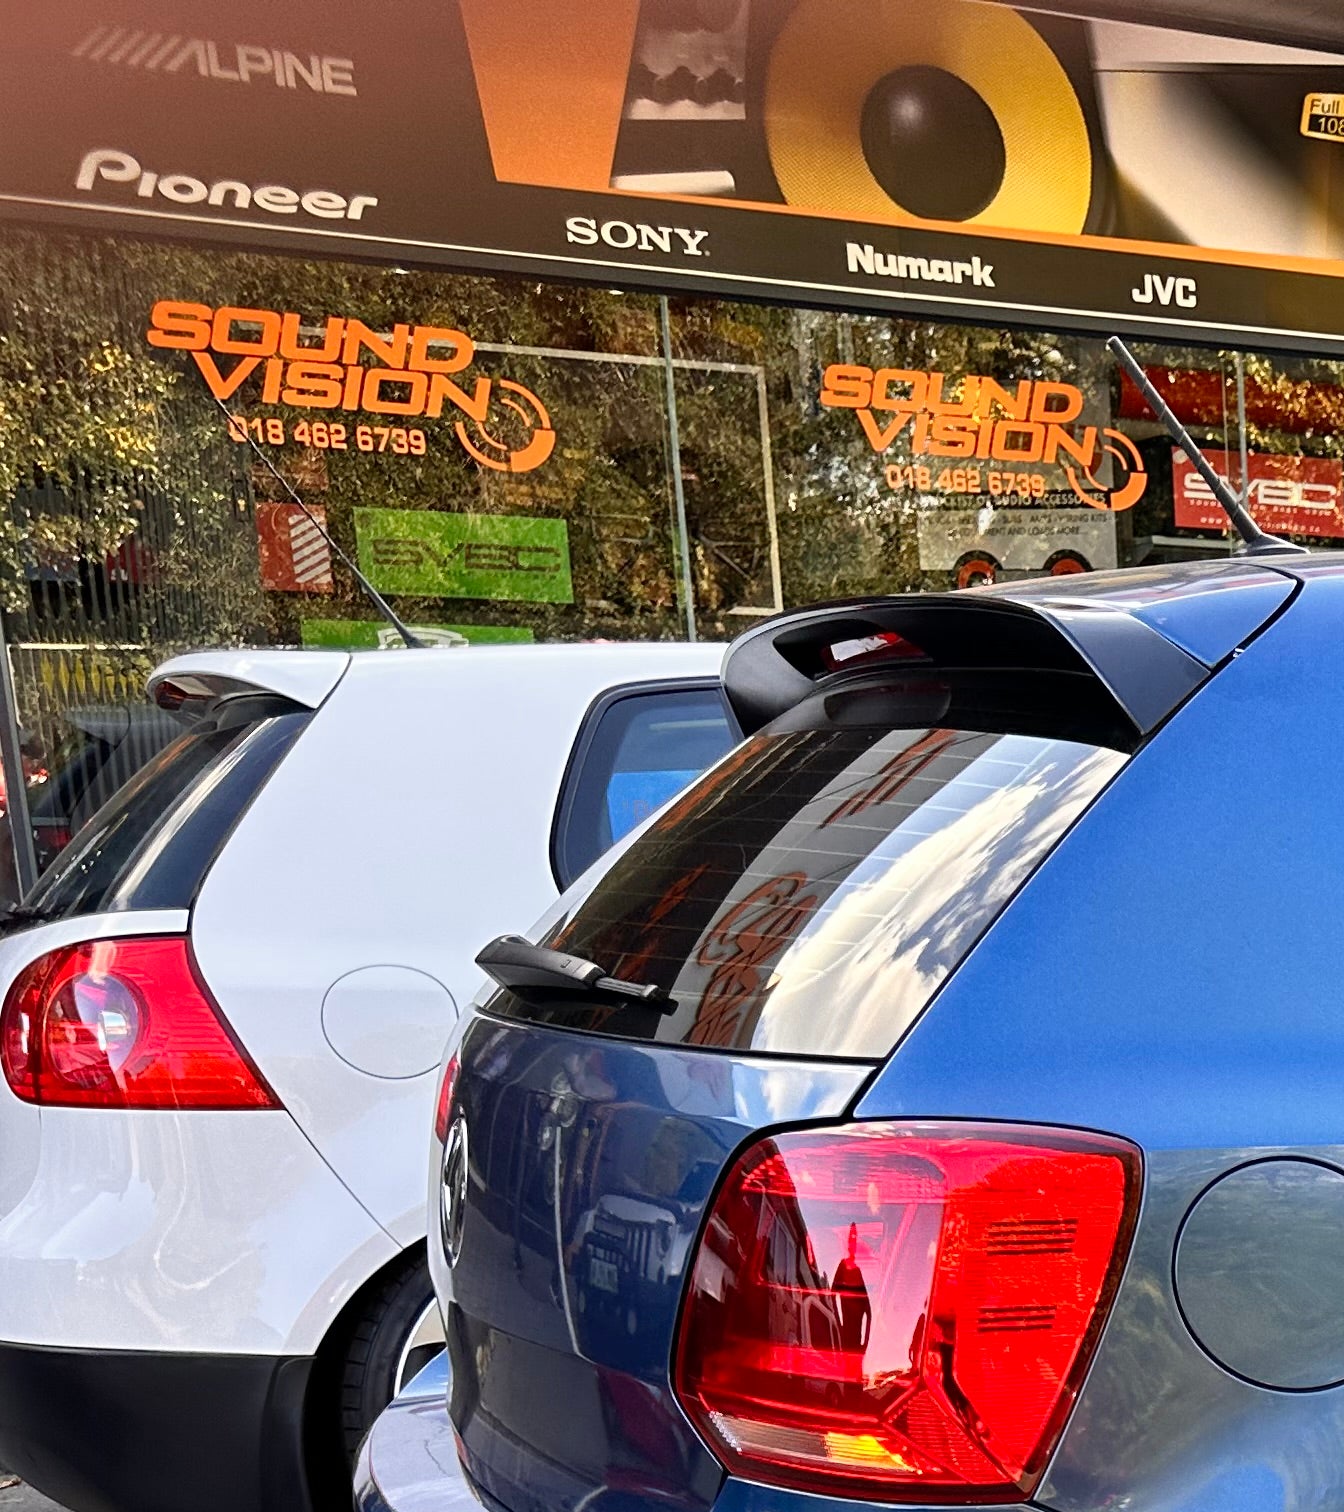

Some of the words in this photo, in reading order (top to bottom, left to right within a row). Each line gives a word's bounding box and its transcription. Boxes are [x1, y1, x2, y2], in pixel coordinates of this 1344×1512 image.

[163, 36, 358, 97] ALPINE
[1310, 98, 1340, 114] Full
[75, 149, 379, 220] Pioneer
[566, 217, 709, 256] SONY
[846, 242, 996, 288] Numark
[1131, 273, 1198, 309] JVC
[147, 300, 474, 374] SOUND
[192, 351, 492, 422] VISION
[820, 364, 1083, 424] SOUND
[229, 416, 285, 446] 018
[294, 421, 348, 450] 462
[356, 424, 427, 456] 6739
[856, 408, 1097, 467] VISION
[885, 464, 932, 491] 018
[938, 467, 981, 493] 462
[988, 470, 1045, 497] 6739
